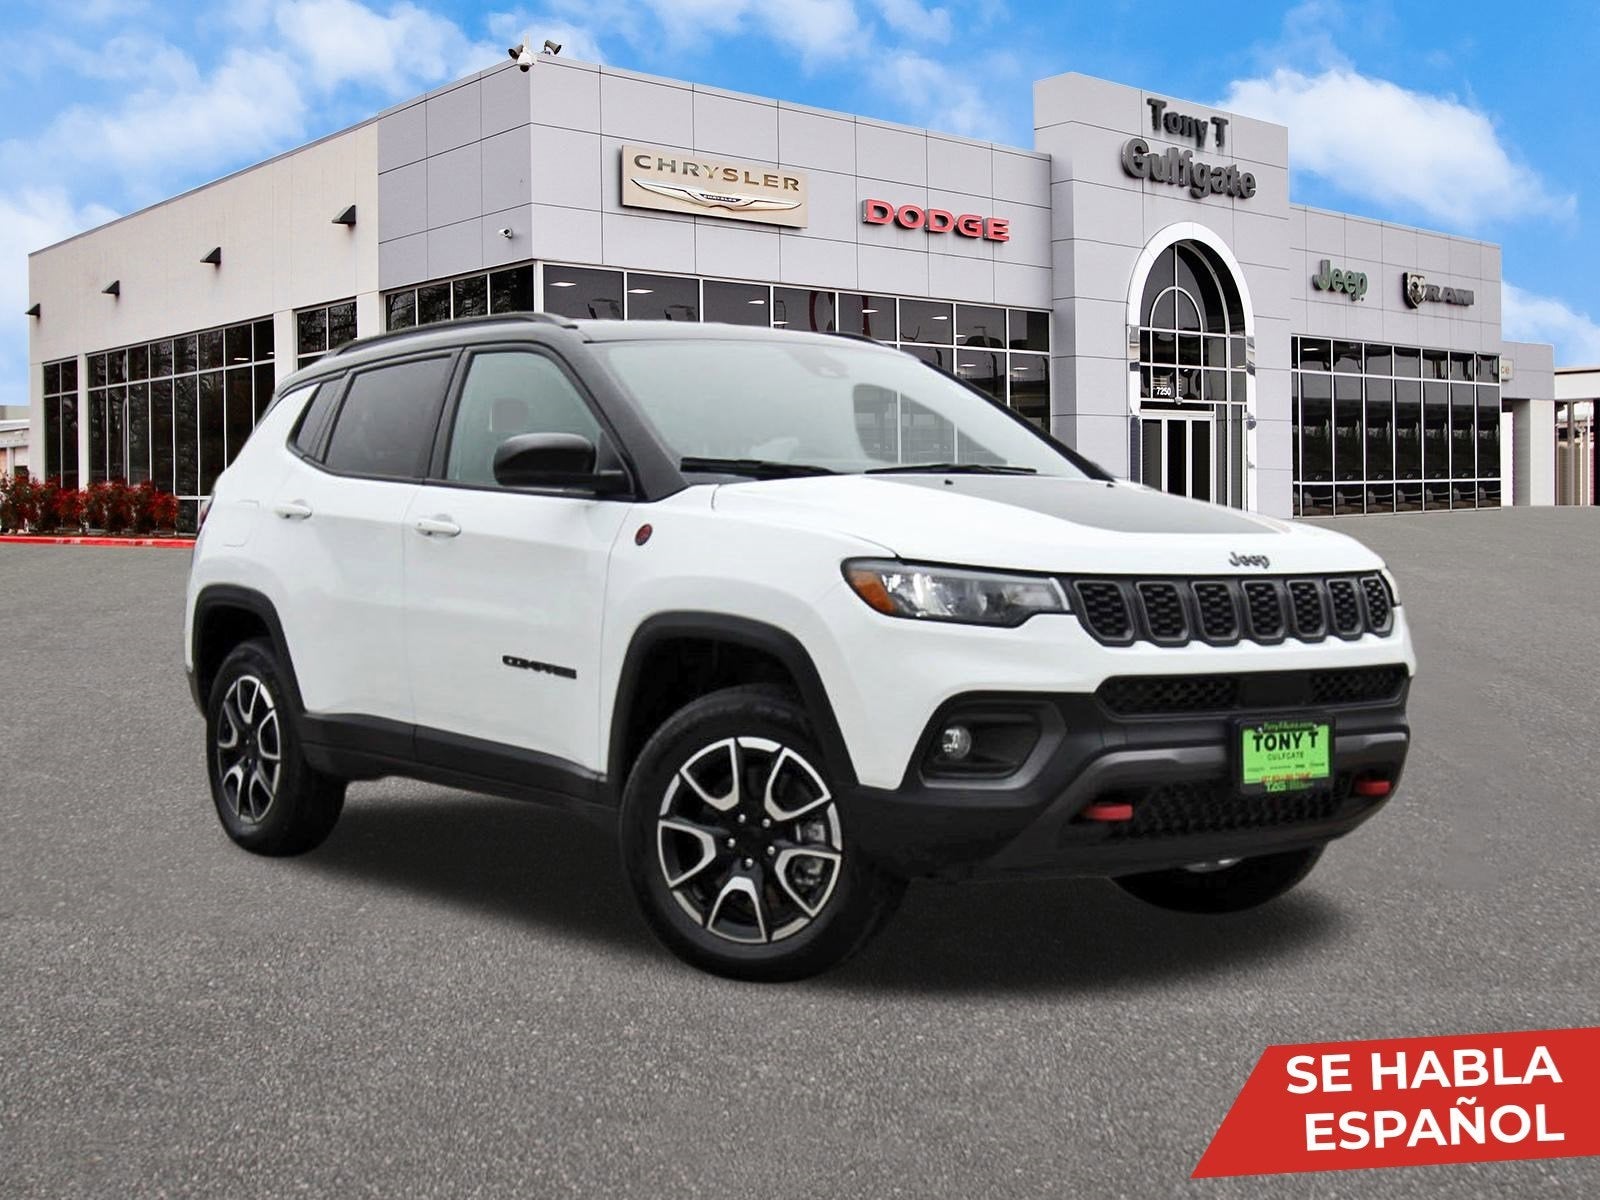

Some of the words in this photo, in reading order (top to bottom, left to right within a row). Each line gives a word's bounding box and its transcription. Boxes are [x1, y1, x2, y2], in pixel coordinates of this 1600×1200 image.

[1146, 97, 1208, 148] Tony
[1210, 116, 1229, 148] T
[634, 154, 800, 192] CHRYSLER
[1121, 138, 1256, 199] Gulfgate
[862, 198, 1010, 242] DODGE
[1312, 259, 1368, 301] Jeep
[1425, 284, 1475, 306] RAM
[1228, 551, 1271, 569] Jeep
[1252, 732, 1304, 752] TONY
[1308, 731, 1319, 748] T
